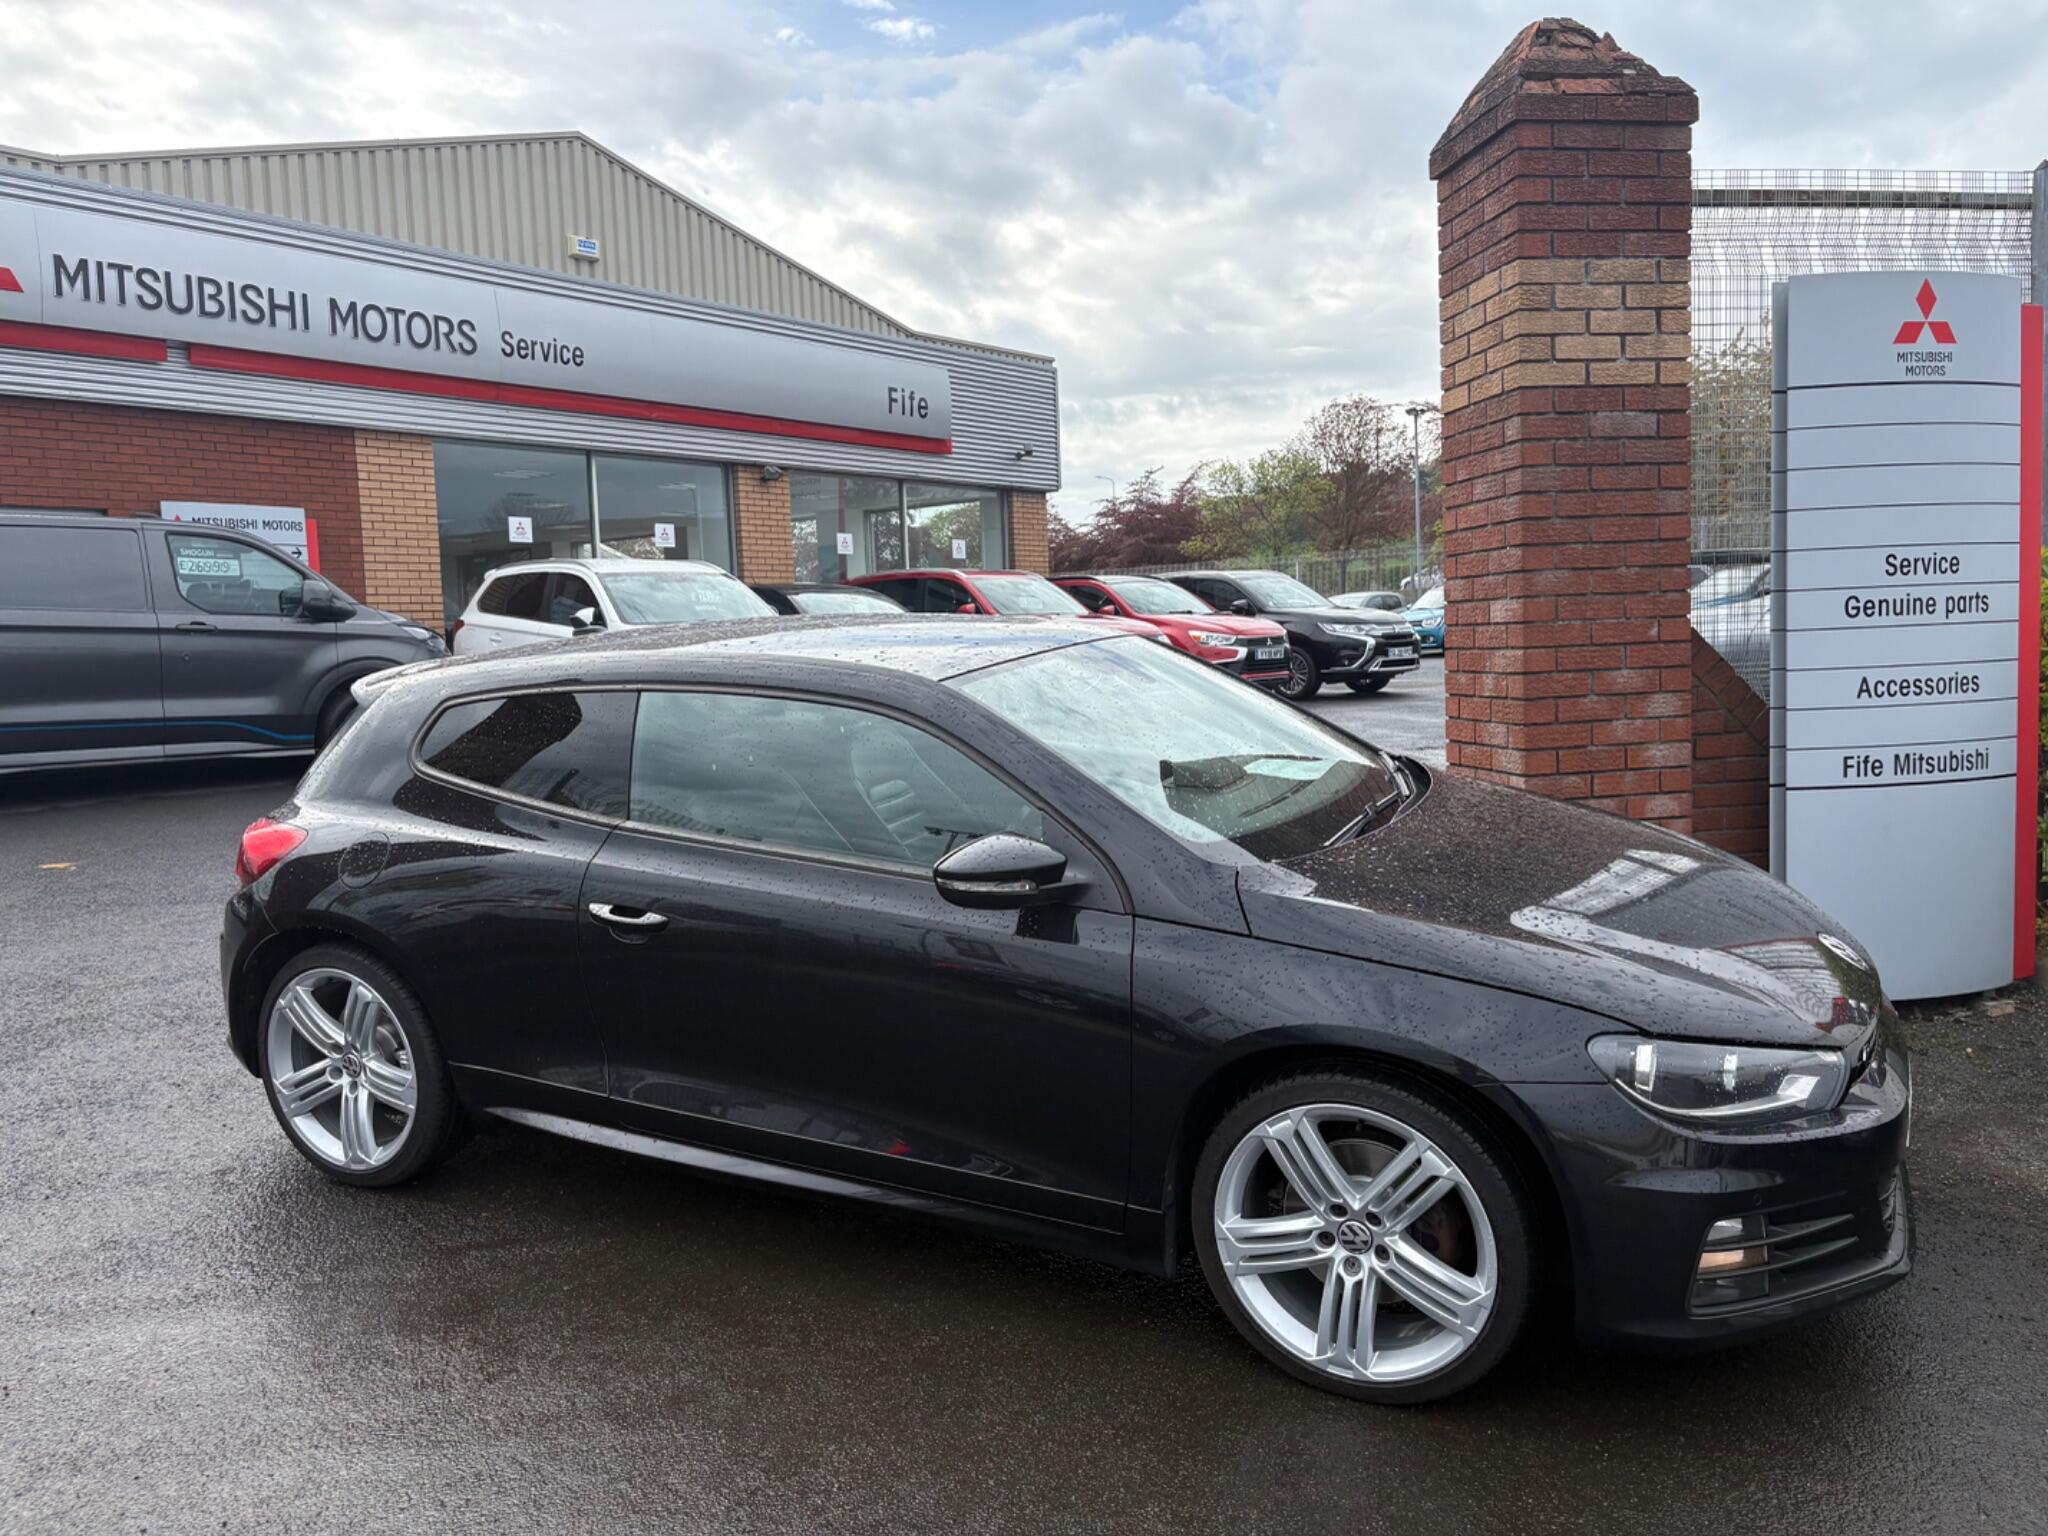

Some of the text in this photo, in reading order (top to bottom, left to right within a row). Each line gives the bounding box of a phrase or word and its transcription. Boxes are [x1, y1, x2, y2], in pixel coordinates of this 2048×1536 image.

[52, 253, 479, 356] MITSUBISHI MOTORS
[500, 330, 585, 367] Service
[1896, 351, 1953, 363] MITSUBISHI
[1905, 365, 1946, 377] MOTORS
[887, 386, 929, 419] Fife
[262, 519, 304, 532] MOTORS
[1885, 552, 1960, 576] Service
[1844, 591, 1990, 619] Genuine parts
[1856, 671, 1980, 699] Accessories
[1842, 748, 1990, 778] Fife Mitsubishi
